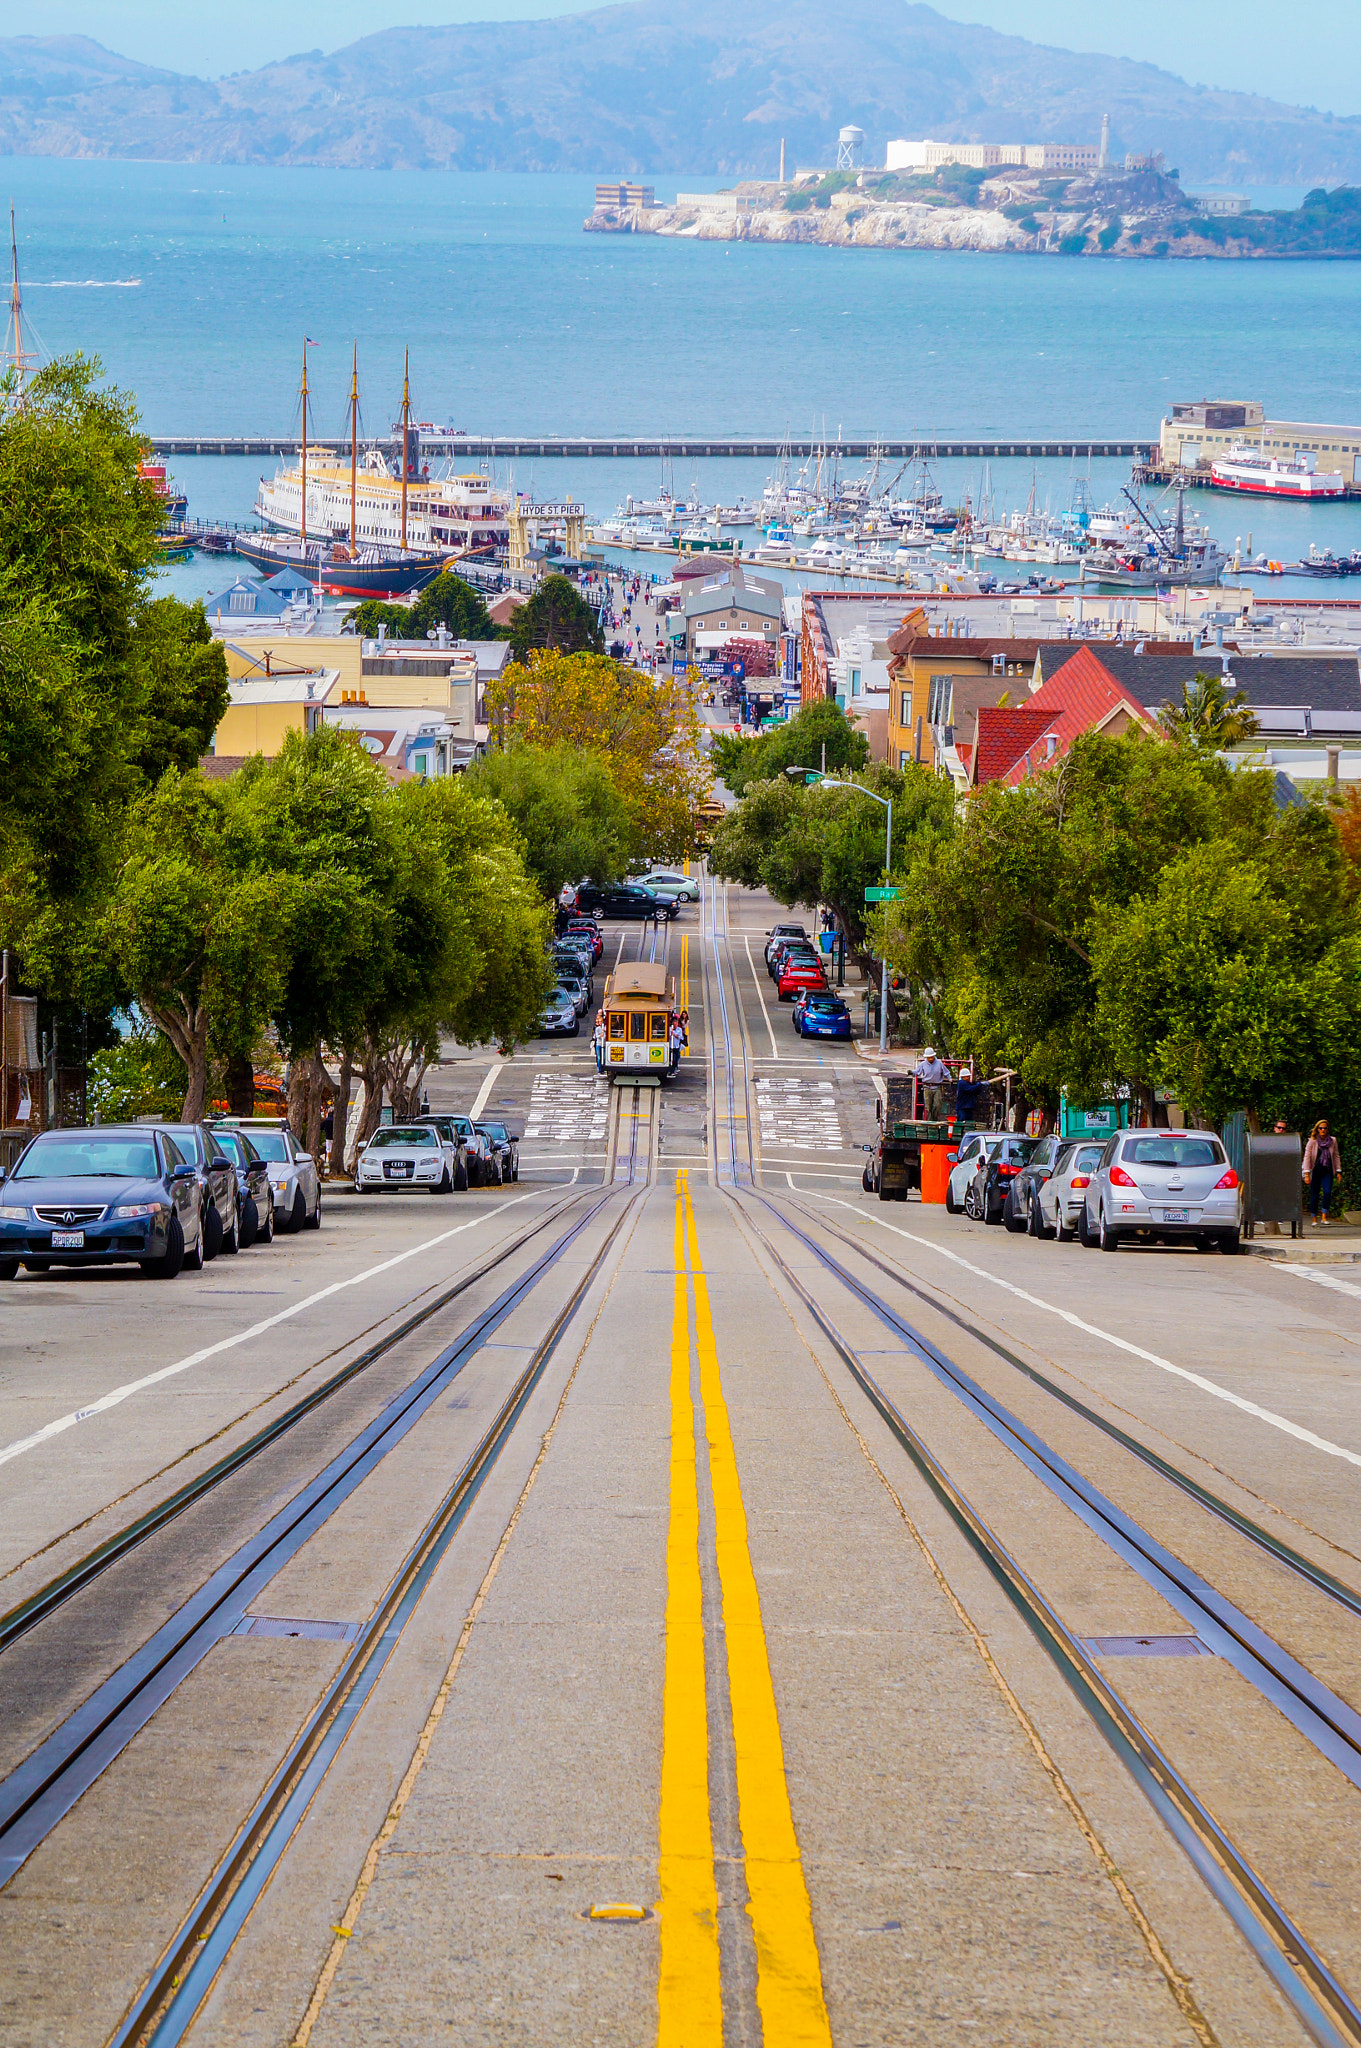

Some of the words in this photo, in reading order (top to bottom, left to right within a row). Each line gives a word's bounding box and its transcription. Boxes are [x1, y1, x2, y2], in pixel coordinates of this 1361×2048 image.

[522, 506, 545, 515] HYDE
[548, 506, 559, 515] ST.
[561, 505, 580, 514] PIER
